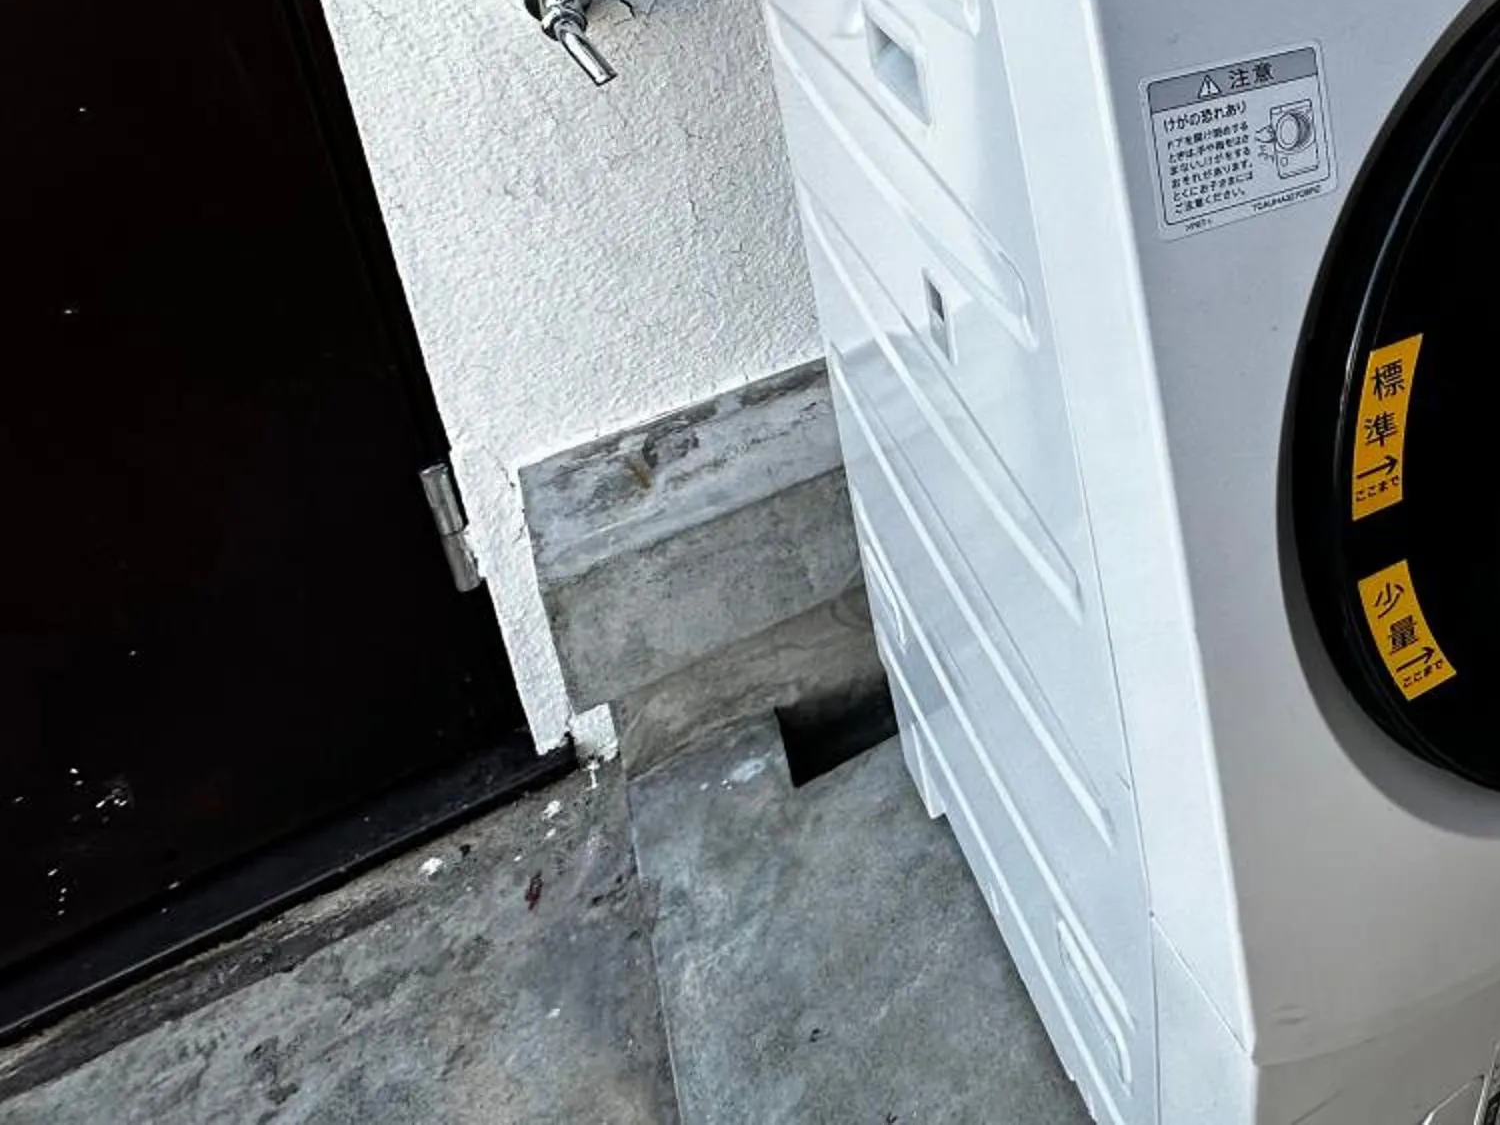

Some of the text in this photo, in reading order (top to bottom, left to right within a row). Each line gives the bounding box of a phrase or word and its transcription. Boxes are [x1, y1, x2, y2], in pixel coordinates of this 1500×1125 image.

[1228, 61, 1274, 88] 注意
[1164, 100, 1247, 133] けがの恐れあり
[1364, 359, 1405, 448] 標準
[1354, 475, 1400, 503] ここまで
[1374, 582, 1419, 656] 少量
[1402, 659, 1444, 689] ここまで
